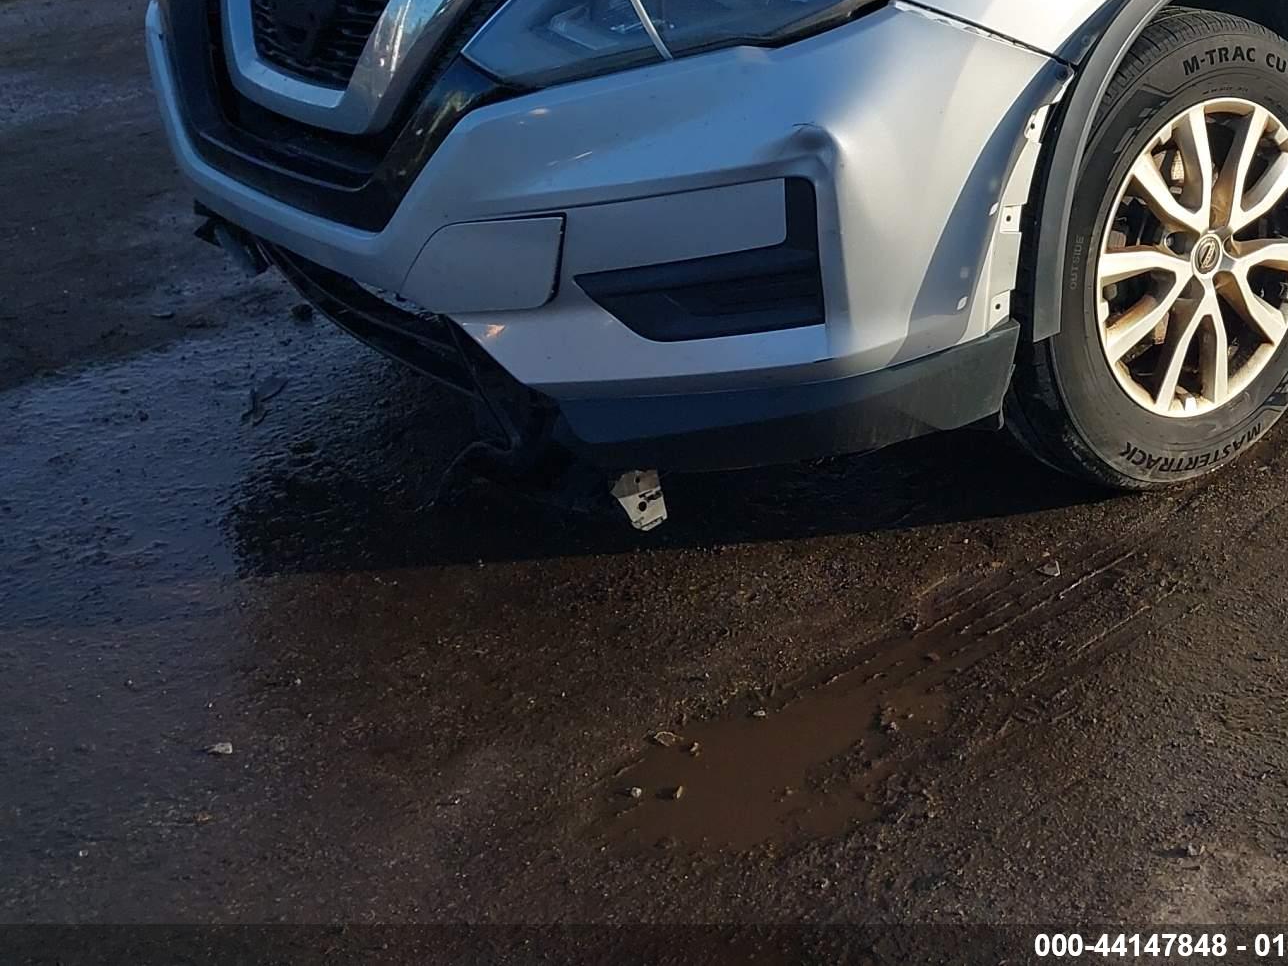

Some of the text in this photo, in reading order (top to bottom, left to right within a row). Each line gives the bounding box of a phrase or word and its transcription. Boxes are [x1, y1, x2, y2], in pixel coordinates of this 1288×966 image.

[1182, 45, 1256, 76] M-TRAC
[1069, 235, 1085, 290] OUTSIDE
[1119, 422, 1262, 472] MASTERTRACK
